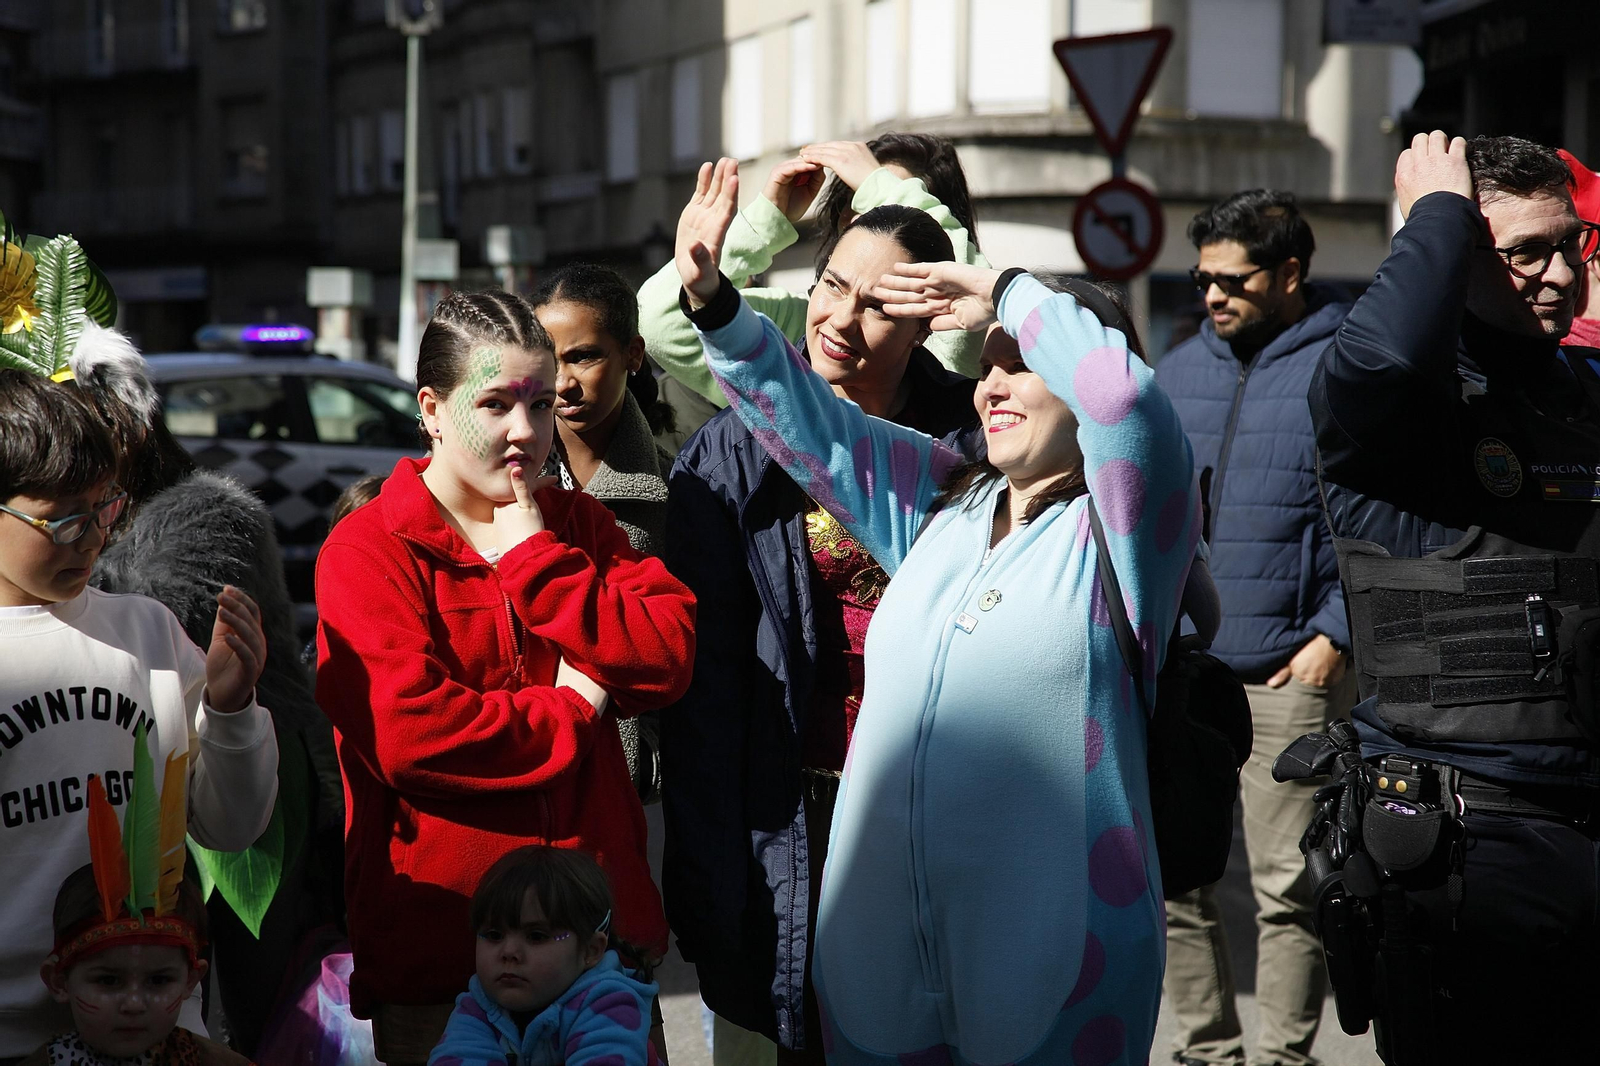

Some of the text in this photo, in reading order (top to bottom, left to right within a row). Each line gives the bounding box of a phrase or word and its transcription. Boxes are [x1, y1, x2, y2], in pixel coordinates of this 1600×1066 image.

[1531, 465, 1579, 474] POLICIA
[0, 686, 155, 757] OWNTOWN
[1, 770, 134, 828] CHICG
